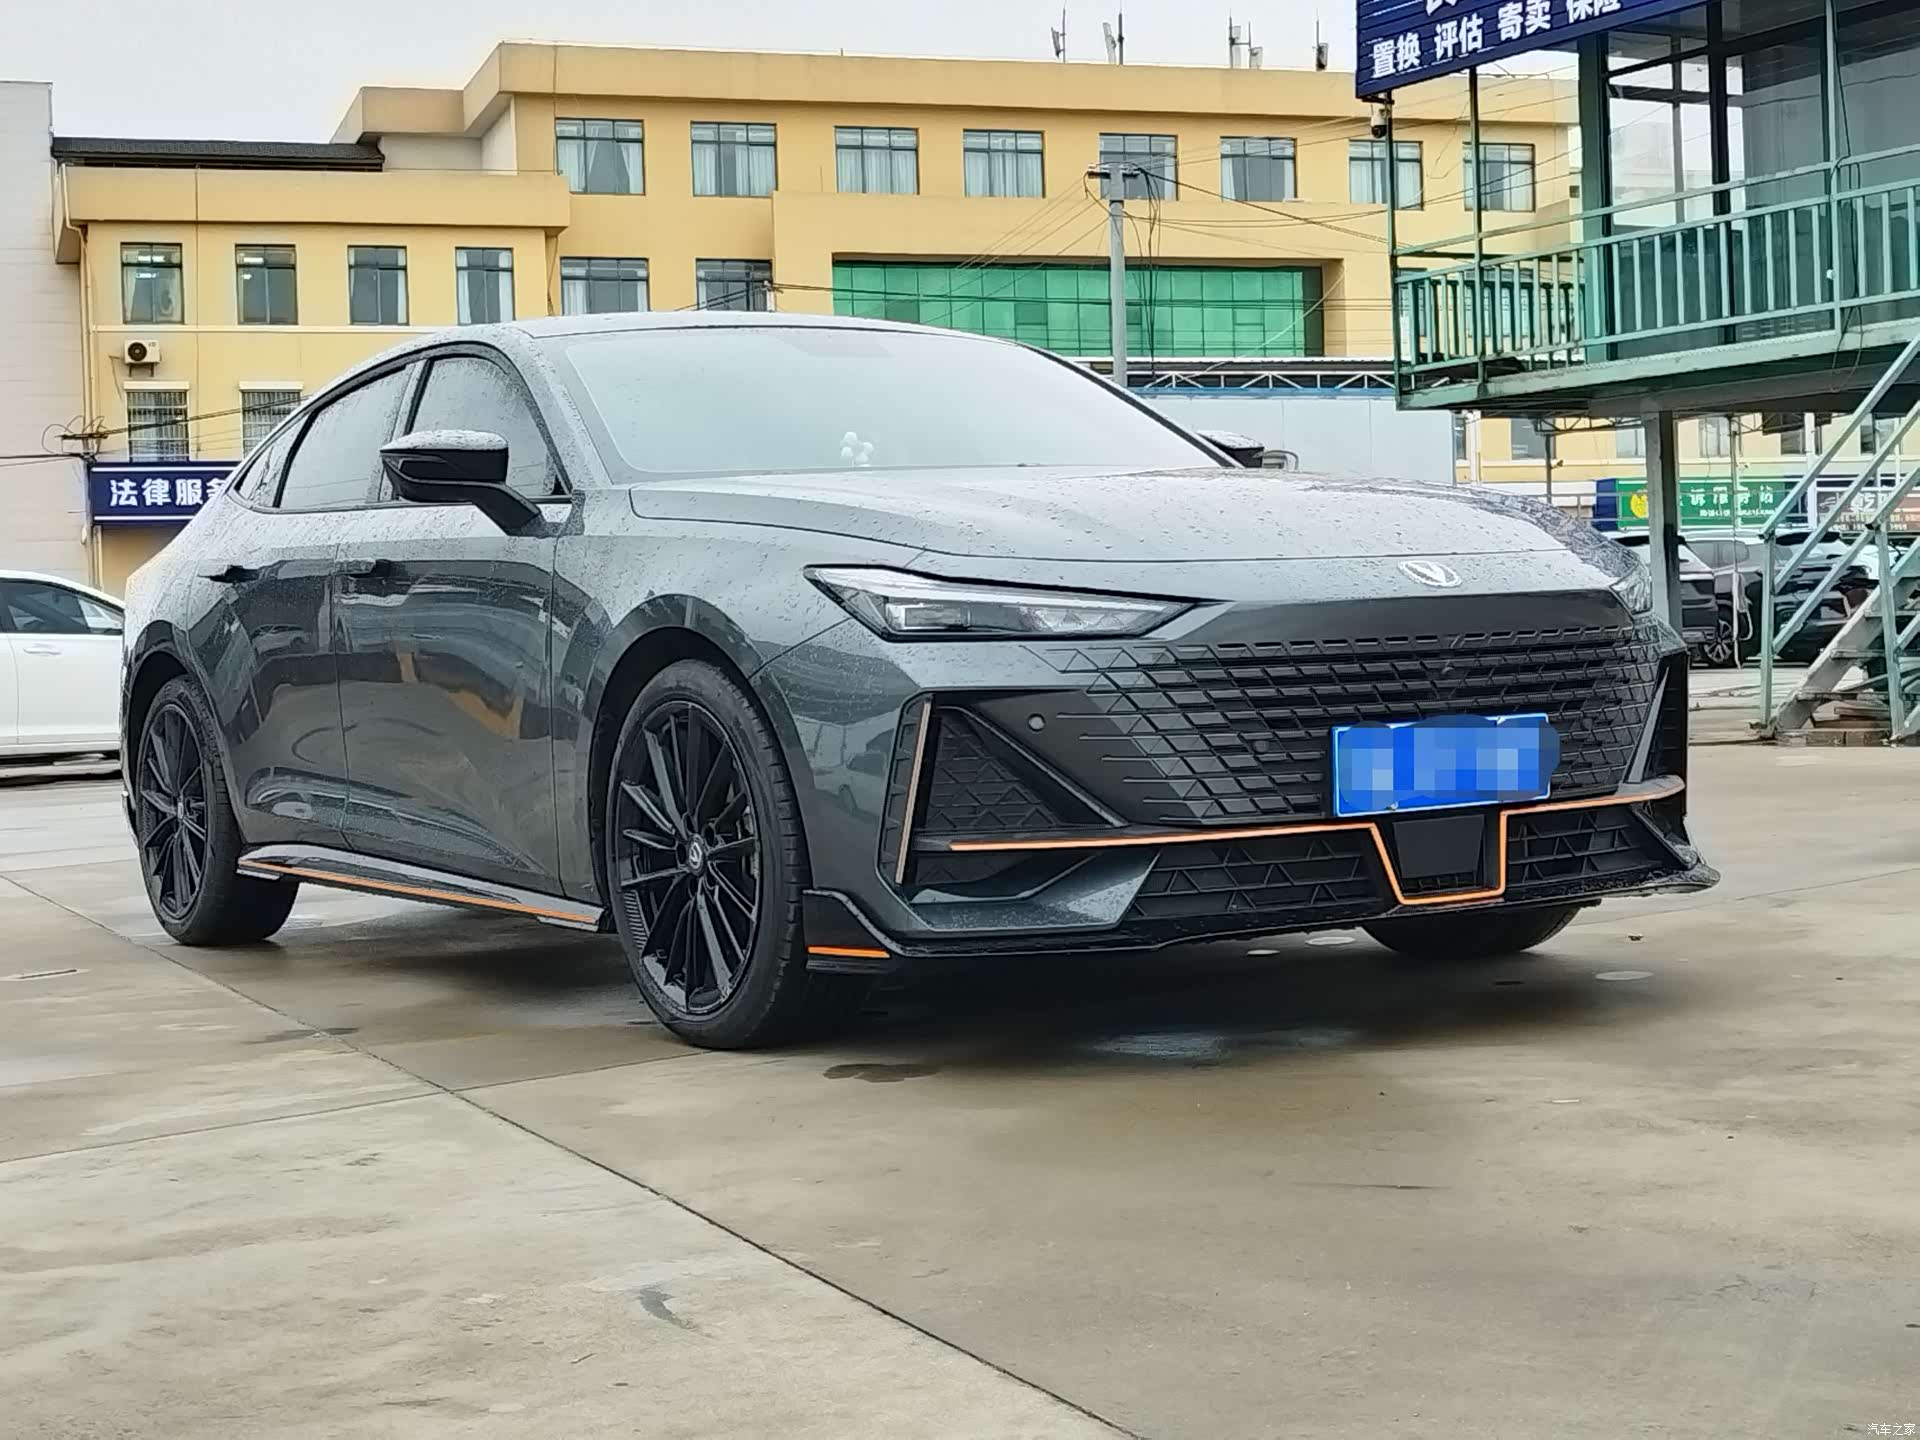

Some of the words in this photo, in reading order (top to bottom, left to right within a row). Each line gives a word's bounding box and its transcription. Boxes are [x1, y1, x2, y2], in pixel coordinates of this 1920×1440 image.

[1372, 32, 1422, 78] 置换
[1434, 12, 1484, 61] 评估
[1497, 0, 1551, 41] 寄卖
